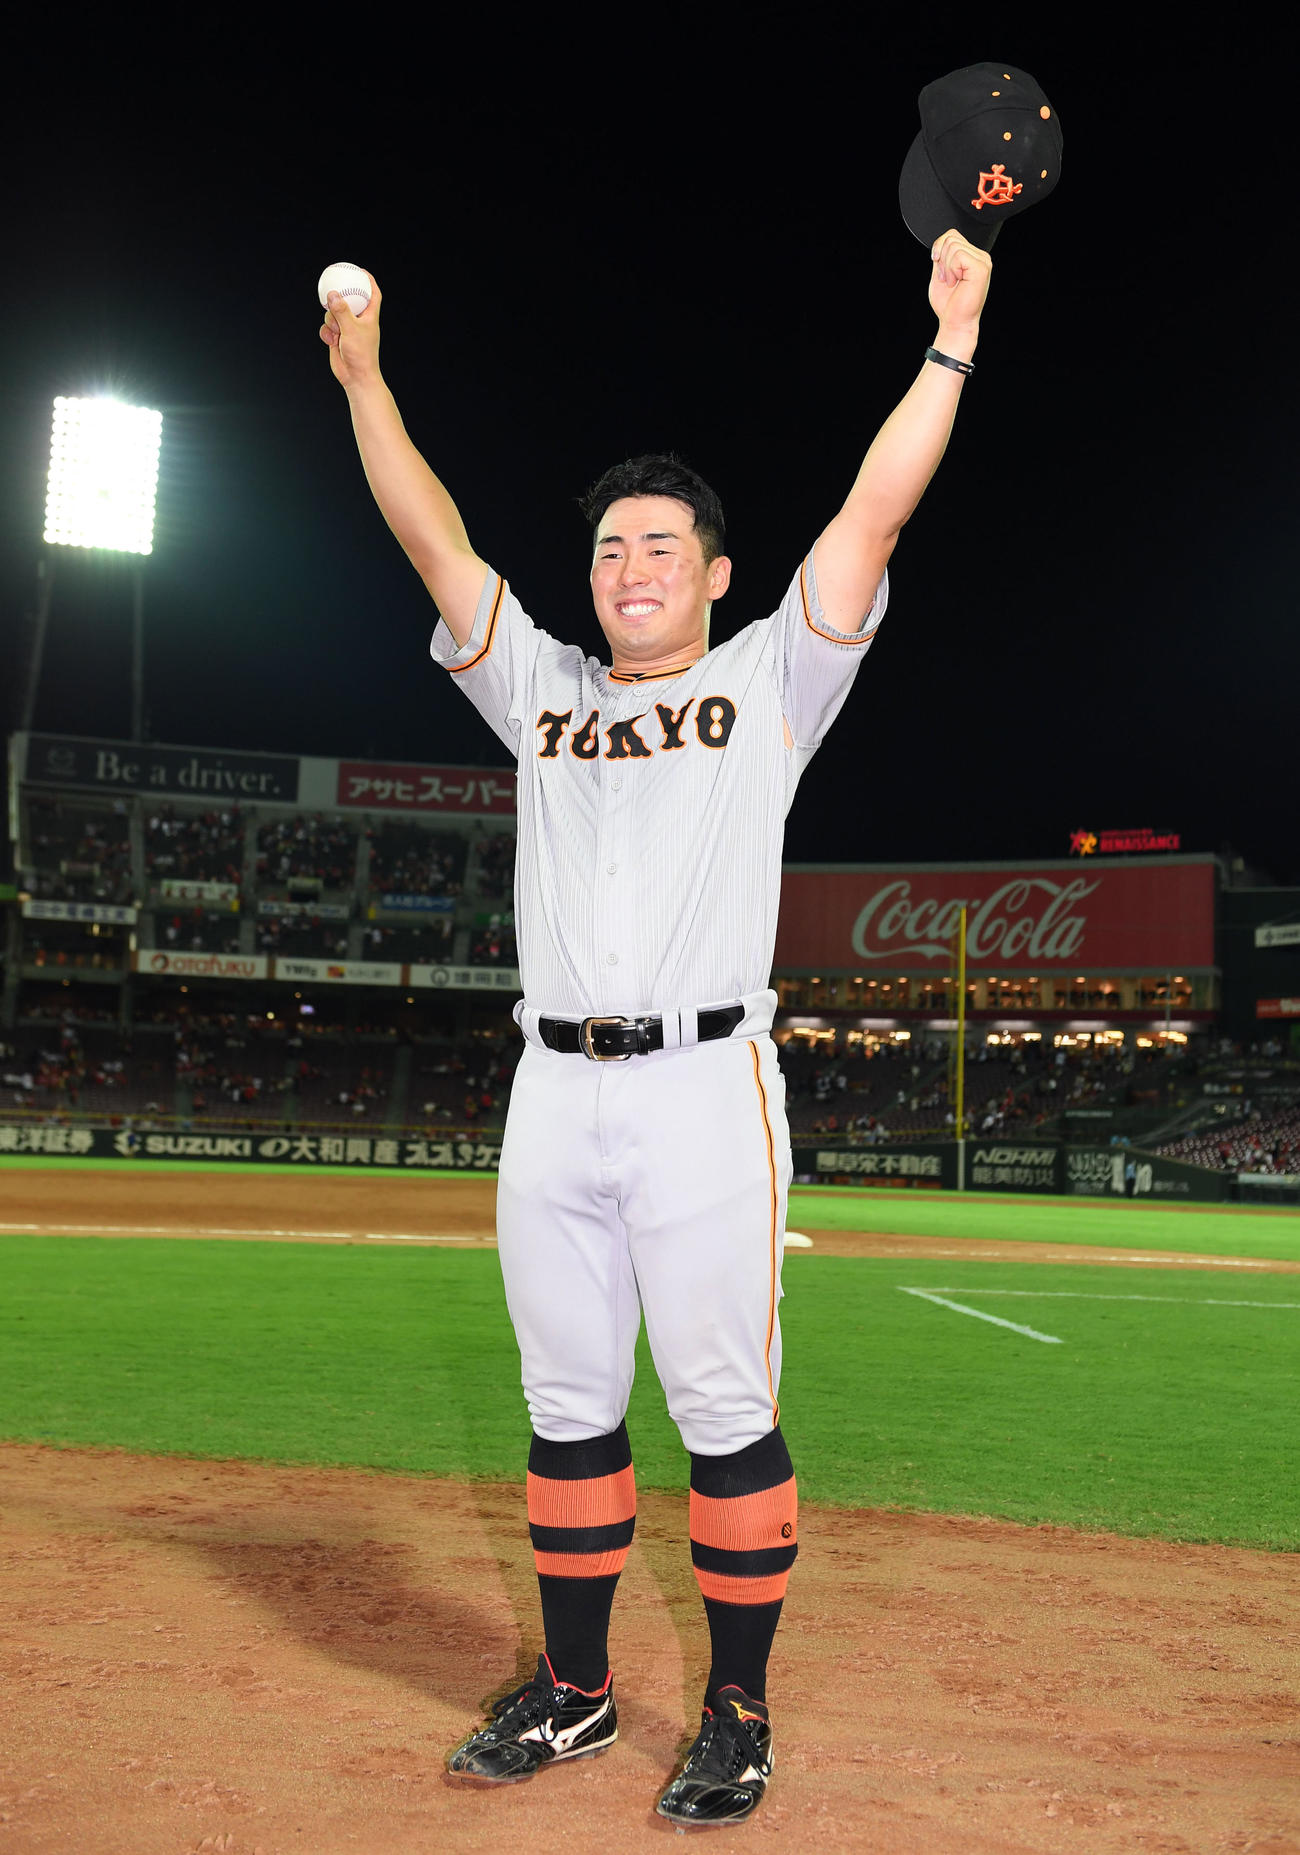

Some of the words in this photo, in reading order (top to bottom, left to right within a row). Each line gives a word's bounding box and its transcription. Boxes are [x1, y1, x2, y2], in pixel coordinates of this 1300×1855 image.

[537, 696, 737, 761] TOKYO
[96, 750, 141, 784] Be
[149, 765, 168, 786] a
[178, 758, 281, 794] driver.
[348, 776, 517, 807] アサヒスーパー
[852, 877, 1103, 960] Coca-Cola
[146, 1136, 252, 1157] SUZUKI
[290, 1137, 399, 1164] 大和興産
[972, 1147, 1057, 1166] NOHMI
[972, 1166, 1055, 1187] 能美防災
